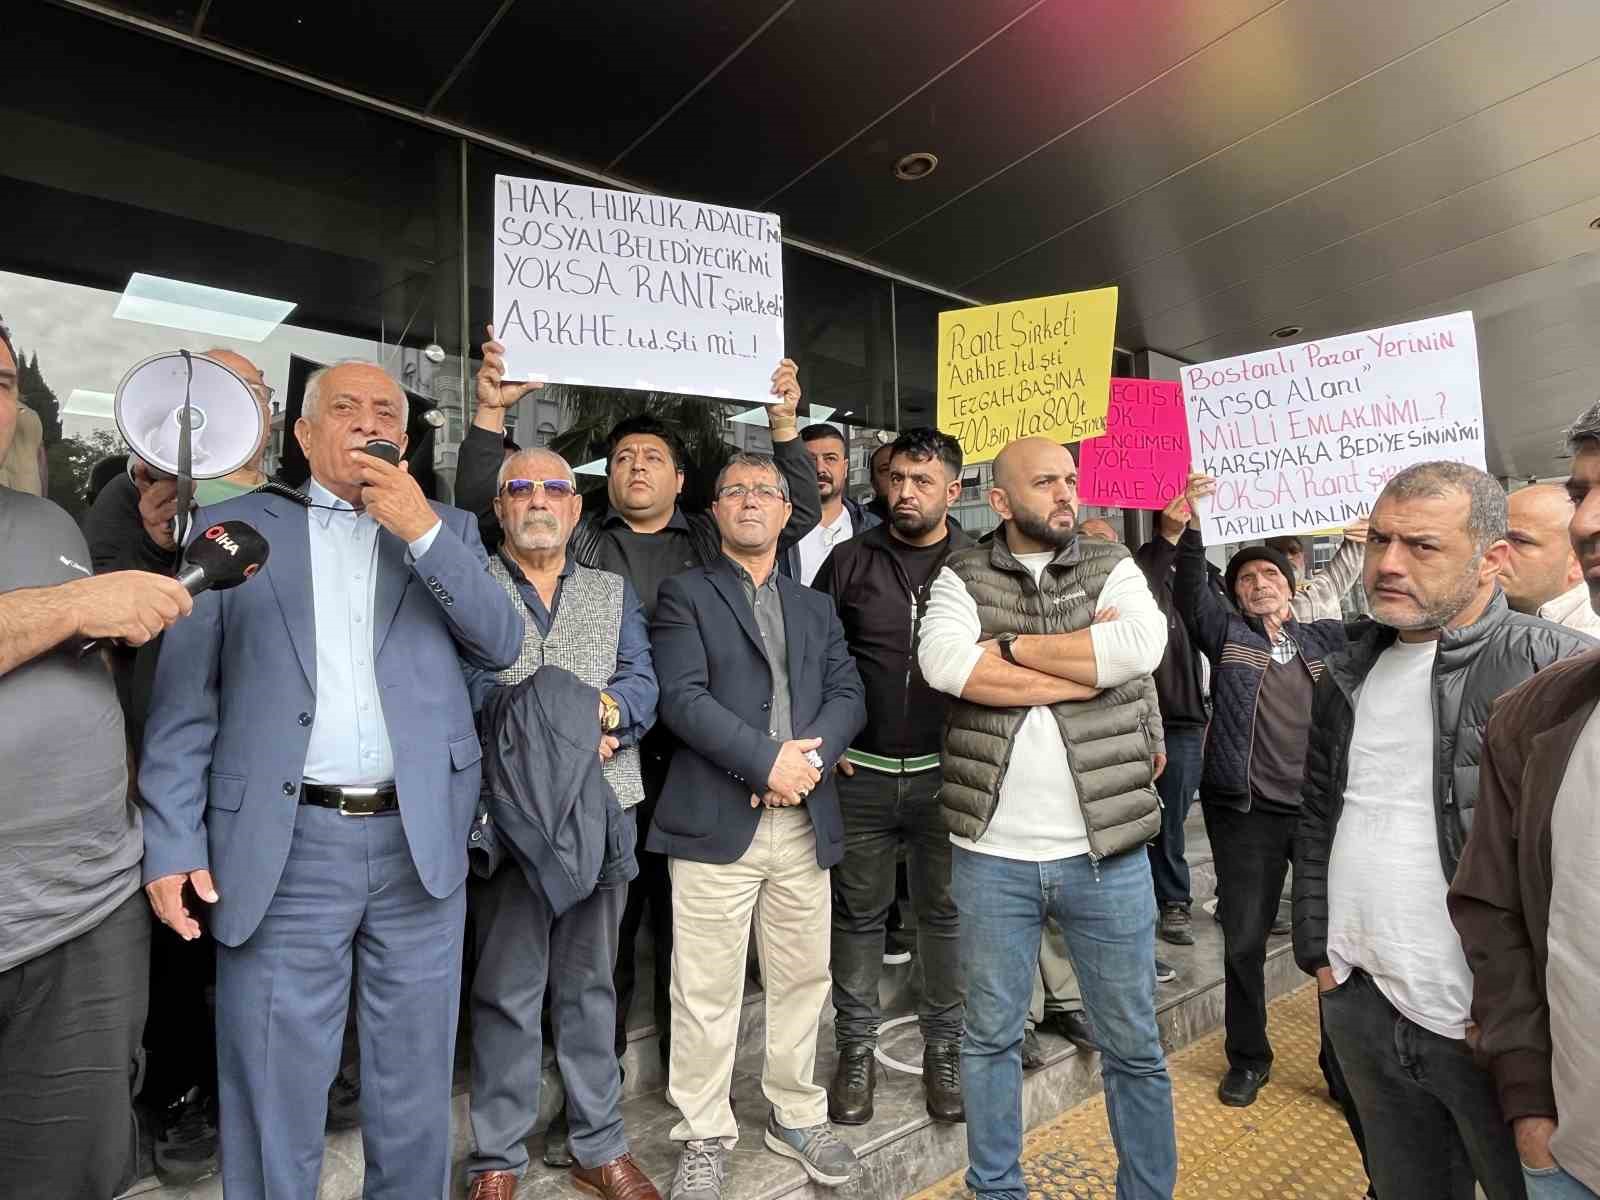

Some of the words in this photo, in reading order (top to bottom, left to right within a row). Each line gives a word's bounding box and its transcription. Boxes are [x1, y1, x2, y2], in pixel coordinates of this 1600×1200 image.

[506, 180, 584, 220] HAK.
[497, 216, 609, 255] SOSYAL
[503, 252, 621, 296] YOKSA
[627, 263, 724, 310] RANT
[947, 322, 1003, 360] Rant
[1187, 351, 1296, 390] Bostanlı
[1302, 343, 1364, 370] Pazar
[947, 384, 1015, 418] TEZGAH
[1199, 413, 1278, 455] MİLLİ
[1203, 439, 1333, 479] KARŞIYAKA
[1296, 459, 1362, 499] Rant
[1210, 511, 1284, 537] TAPULU
